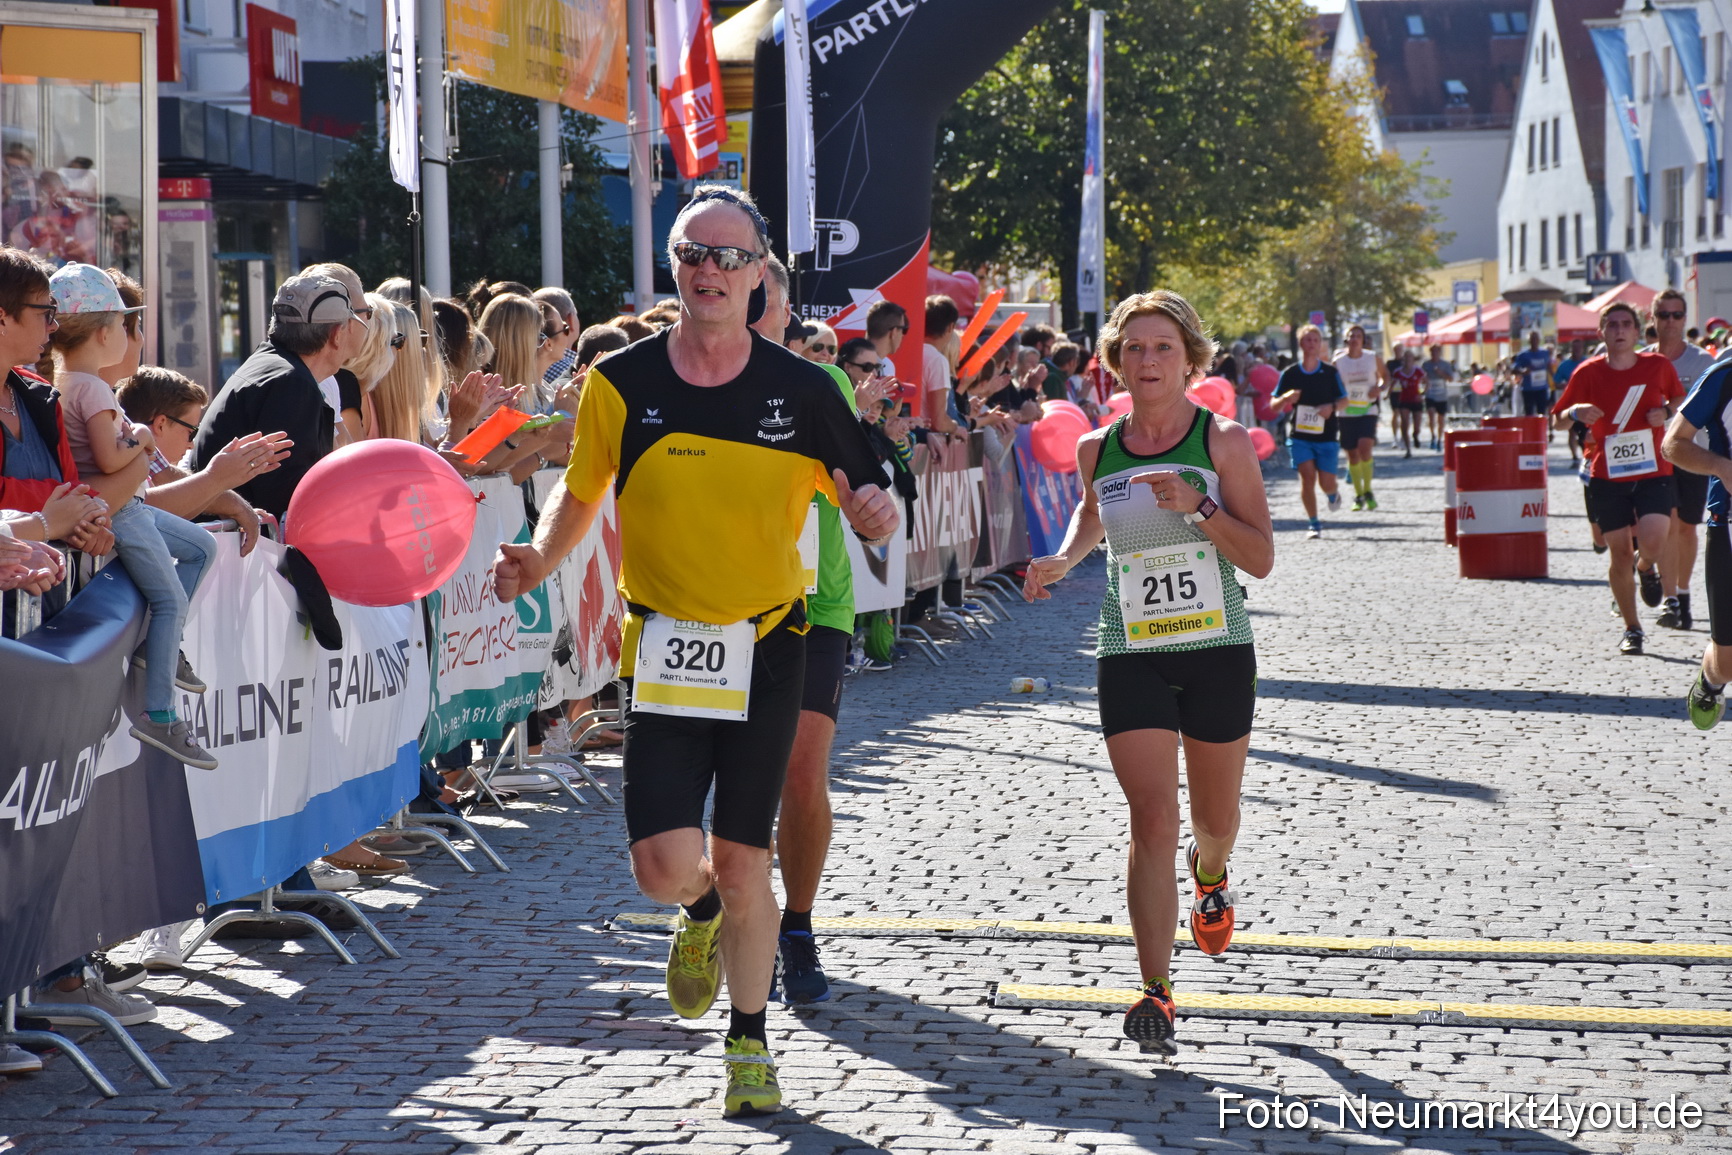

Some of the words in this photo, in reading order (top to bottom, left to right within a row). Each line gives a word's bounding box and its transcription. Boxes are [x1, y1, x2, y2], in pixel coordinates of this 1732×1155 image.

[812, 0, 915, 64] PARTL
[811, 304, 843, 317] NEXT
[766, 398, 785, 407] TSV
[641, 416, 663, 424] erima
[667, 447, 706, 457] Markus
[1612, 442, 1645, 460] 2621
[1144, 552, 1188, 568] BOCK
[1142, 570, 1198, 606] 215
[1143, 608, 1164, 617] PARTL
[1164, 604, 1195, 614] Neumarkt
[674, 619, 723, 632] BOCK
[1148, 617, 1203, 636] Christine
[664, 637, 726, 673] 320
[659, 673, 683, 683] PARTL
[684, 675, 717, 685] Neumarkt
